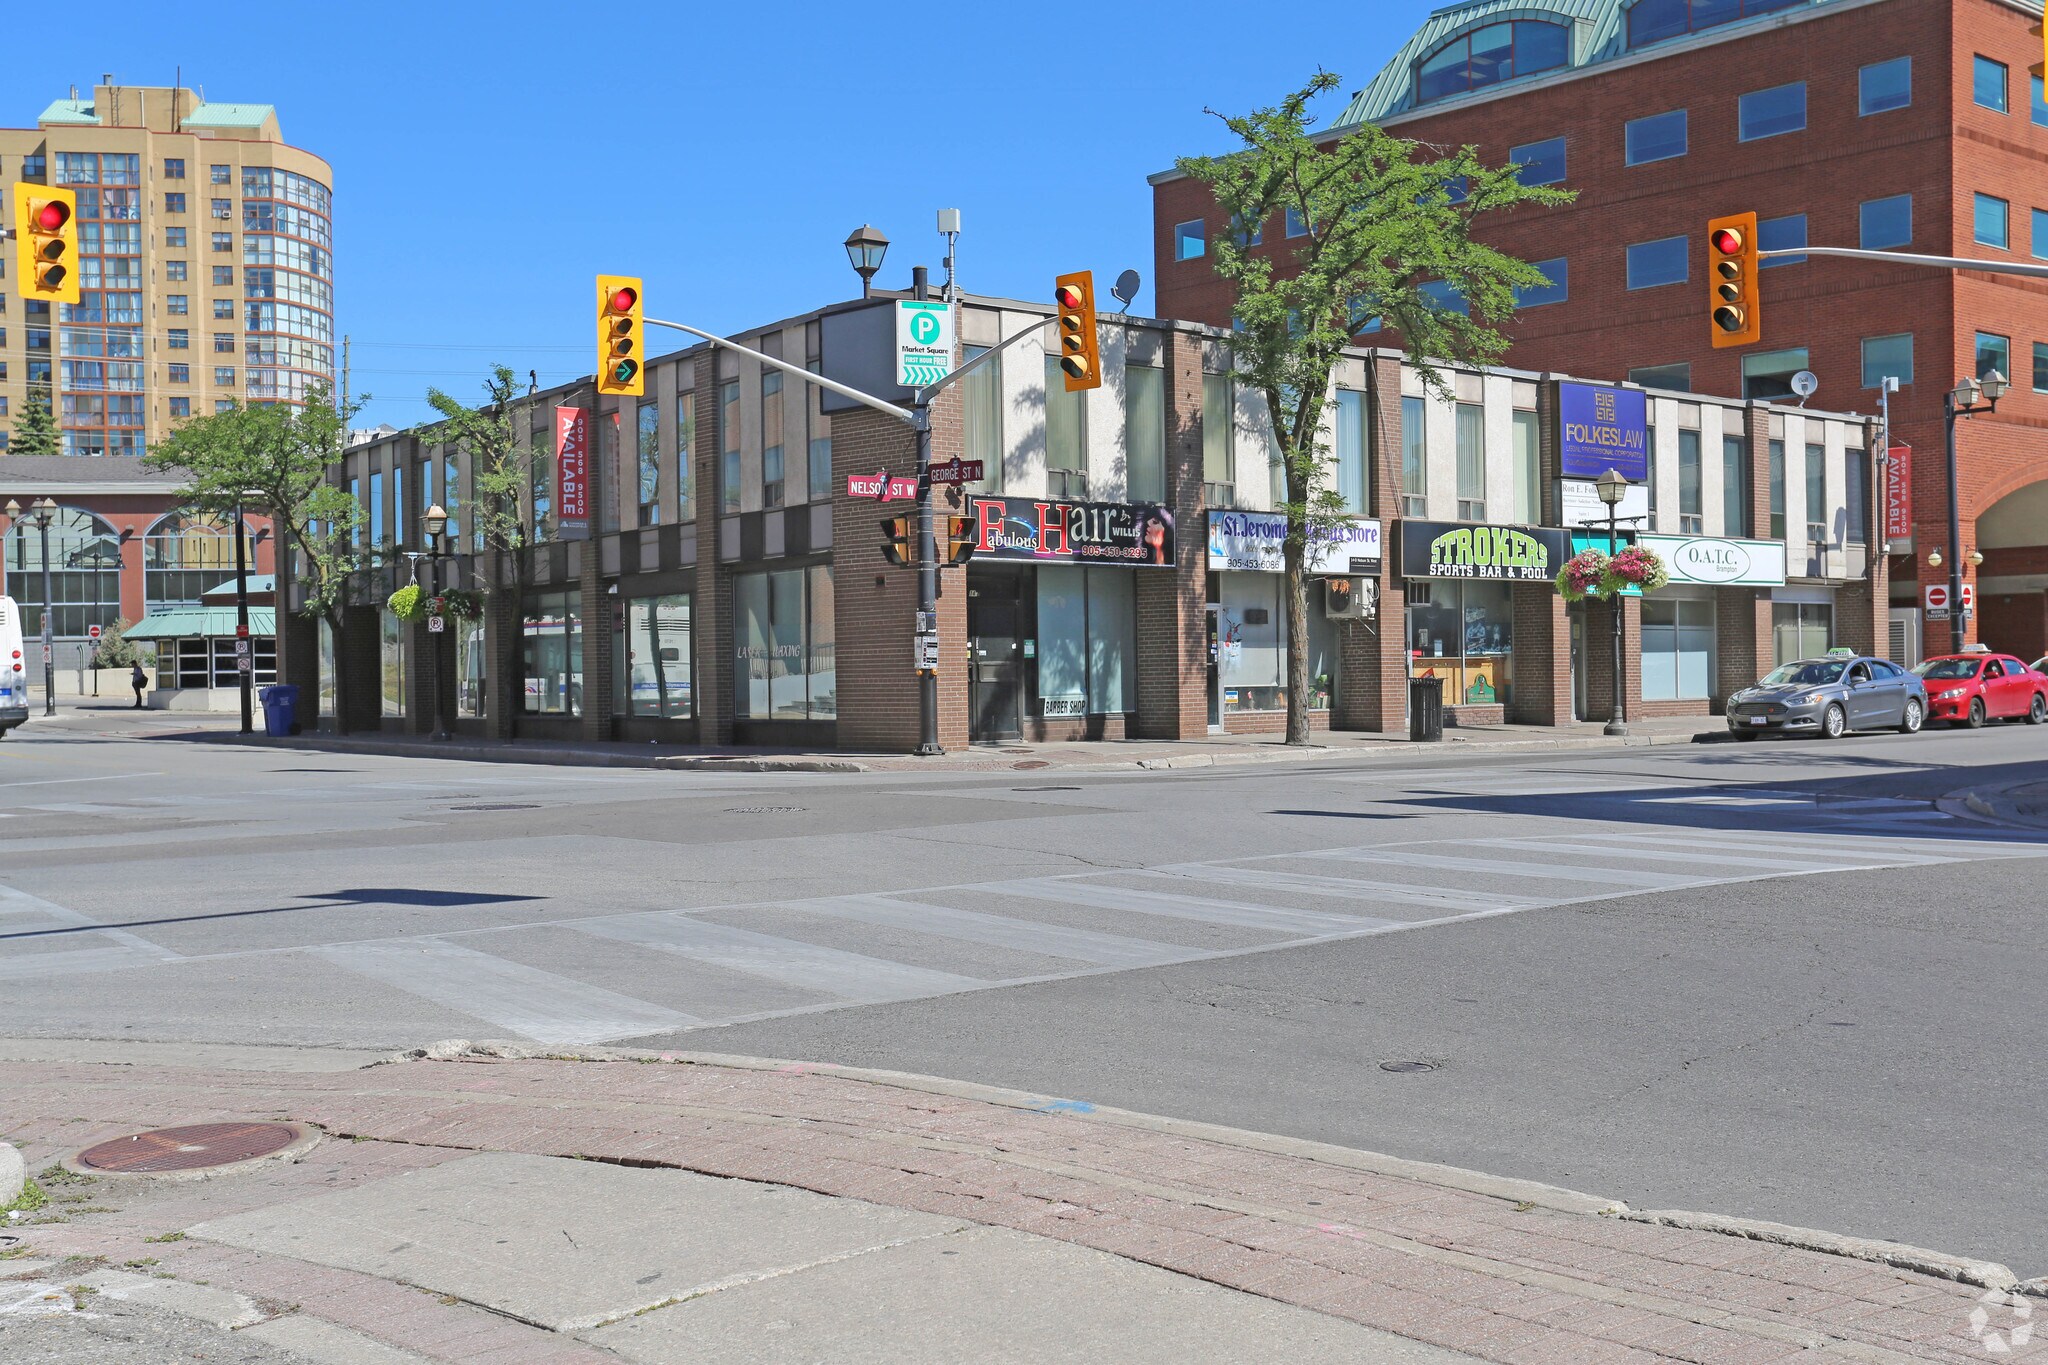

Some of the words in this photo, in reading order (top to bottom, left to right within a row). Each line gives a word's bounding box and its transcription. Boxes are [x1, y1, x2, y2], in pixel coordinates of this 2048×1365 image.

[902, 345, 925, 353] Market
[926, 346, 948, 354] Square
[933, 357, 947, 366] FREE
[1566, 422, 1644, 448] FOLKESLAW
[562, 417, 576, 514] AVAILABLE
[931, 468, 959, 482] GEORGE
[962, 467, 971, 479] ST
[975, 466, 980, 478] N
[851, 482, 888, 495] NELSON
[892, 484, 903, 496] ST
[906, 484, 914, 496] W
[1889, 456, 1900, 534] AVAILABLE
[1034, 502, 1117, 554] Hair
[1112, 527, 1140, 538] WILLIS
[1082, 546, 1147, 558] 905-450-3295
[1430, 527, 1548, 568] STROKERS
[1688, 547, 1738, 564] O.A.T.C.
[1227, 558, 1280, 570] 905-453-6086
[1716, 565, 1737, 573] Brampton
[1430, 564, 1474, 577] SPORTS
[1479, 566, 1502, 578] BAR
[1508, 567, 1515, 578] &
[1521, 567, 1548, 579] POOL
[1046, 701, 1068, 714] BARBER
[1070, 700, 1085, 714] SHOP
